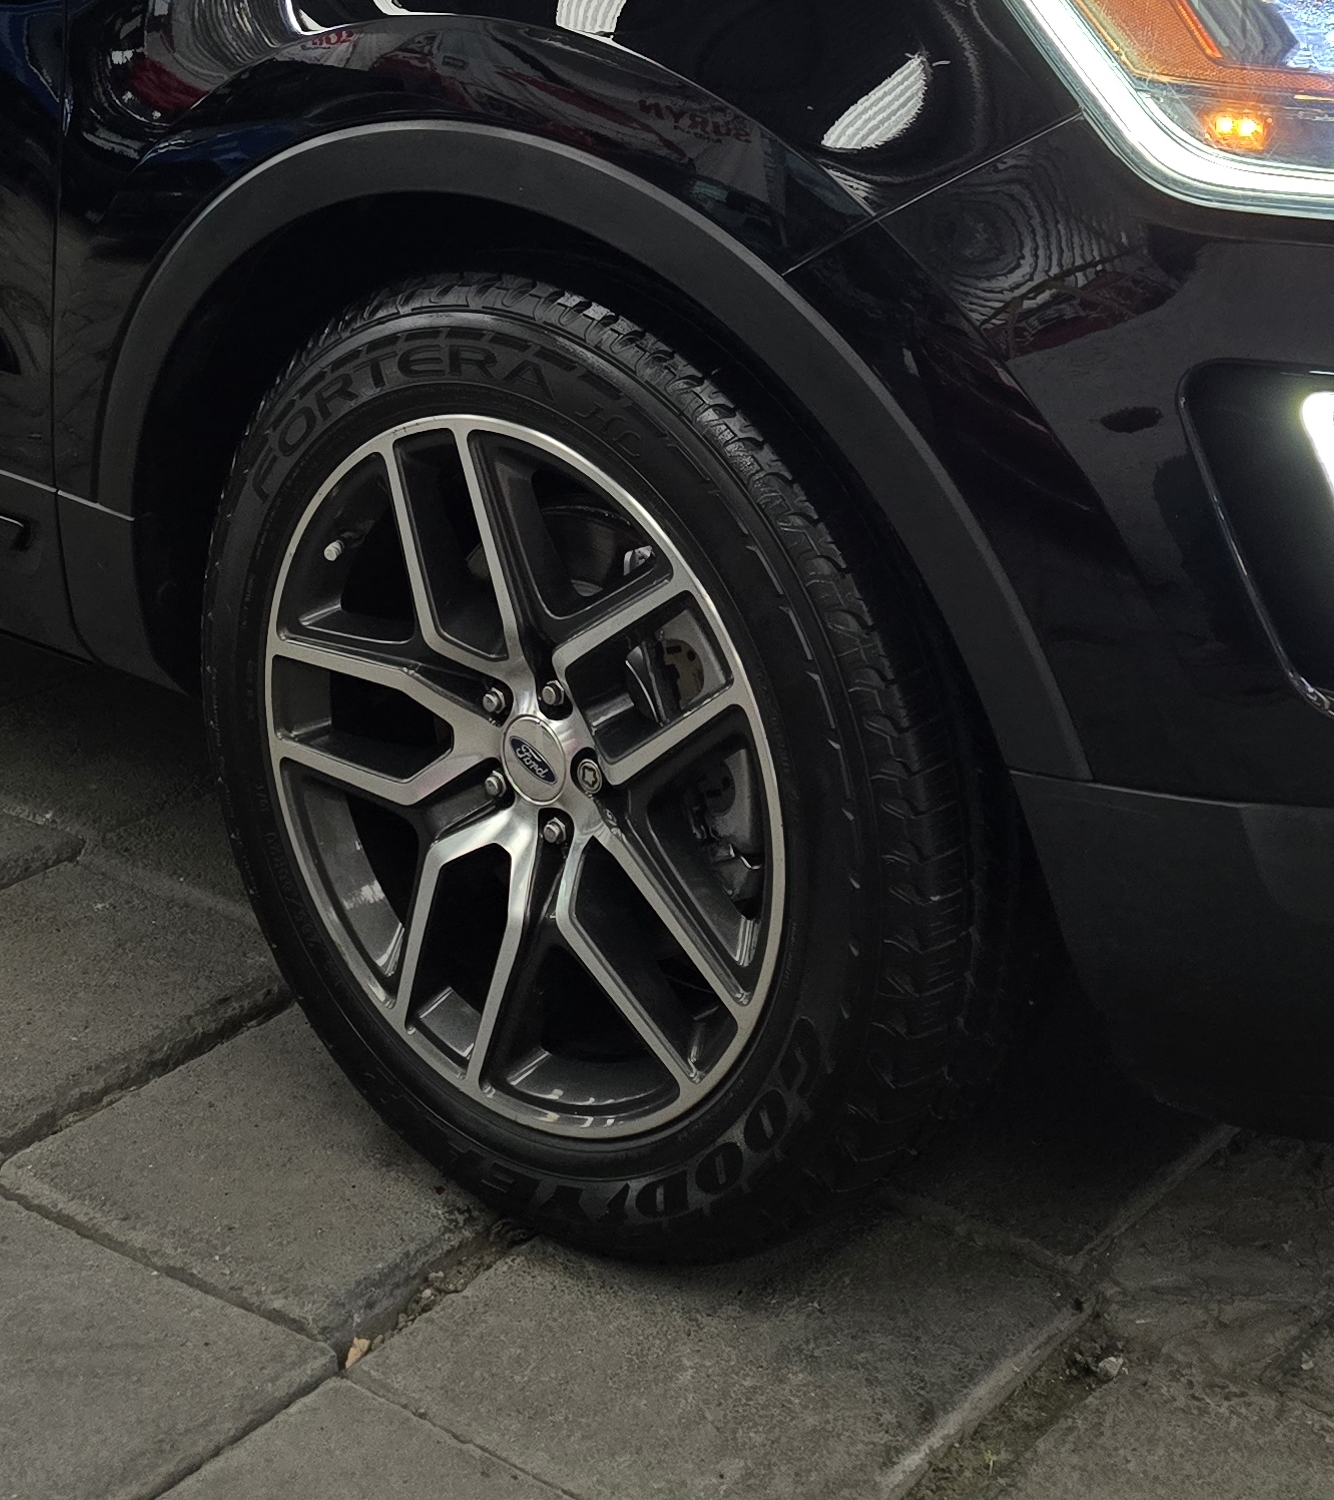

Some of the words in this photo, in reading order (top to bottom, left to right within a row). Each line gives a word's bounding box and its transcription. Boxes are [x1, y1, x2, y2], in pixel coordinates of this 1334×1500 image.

[250, 342, 556, 504] FORTERA
[515, 743, 550, 779] Ford
[370, 1013, 830, 1229] GOODYE
